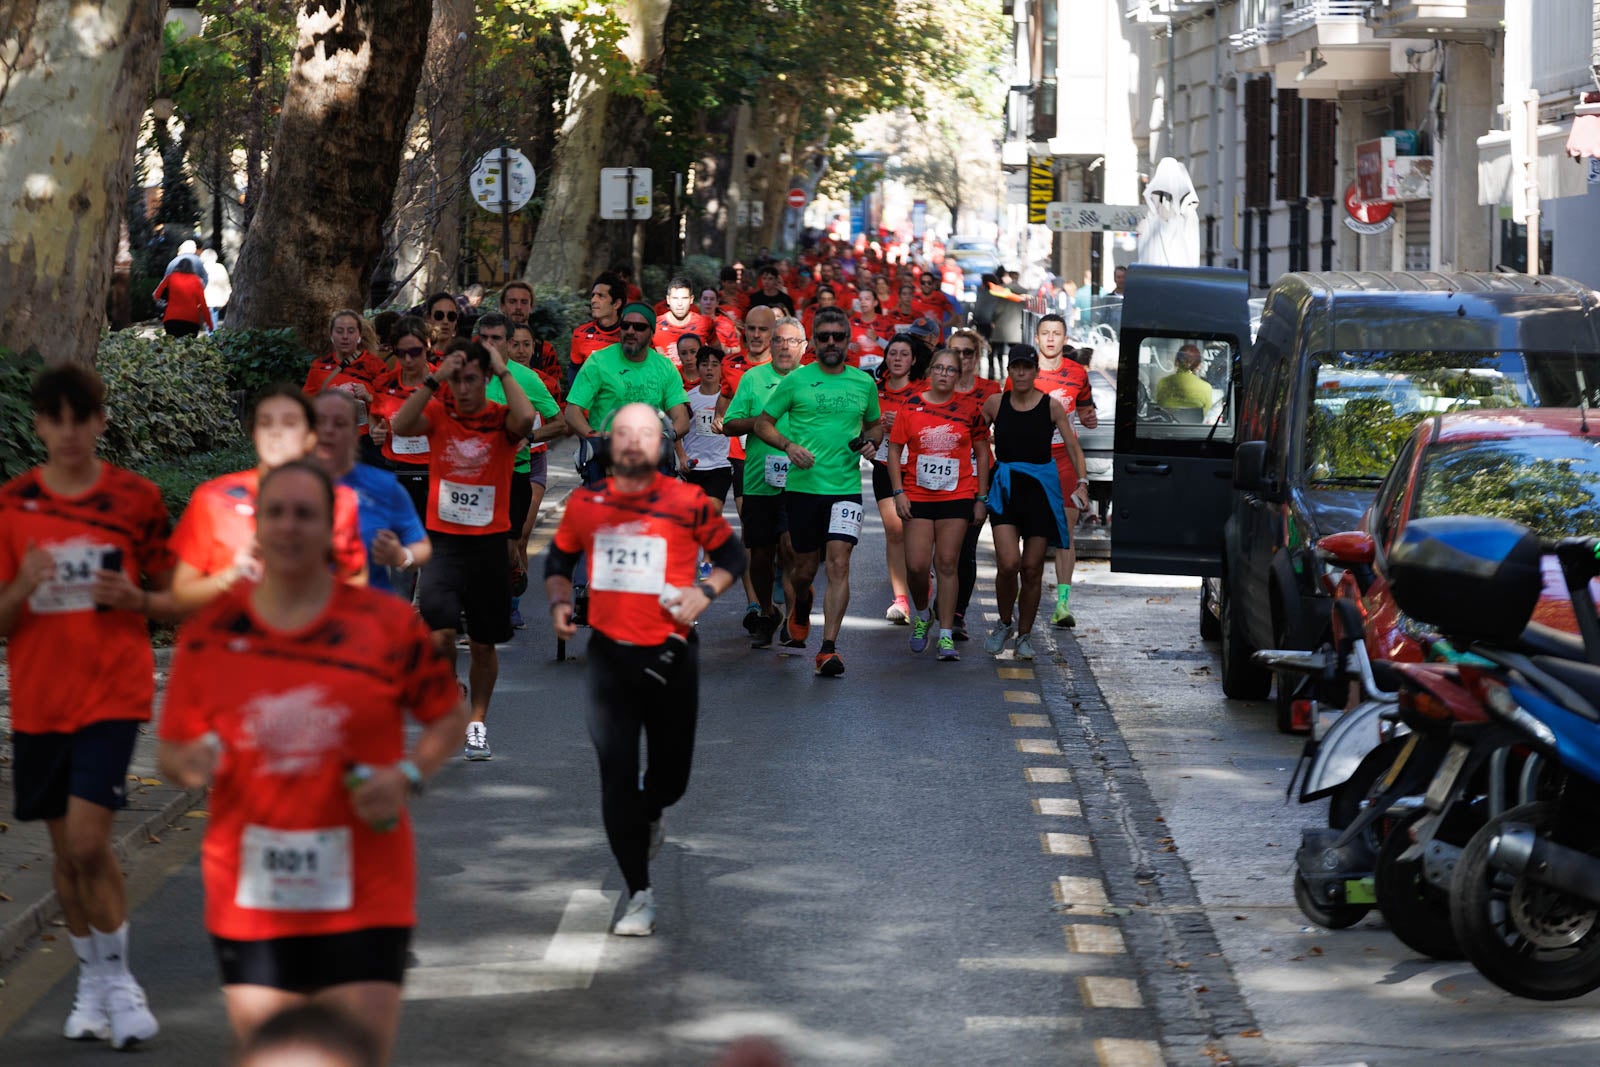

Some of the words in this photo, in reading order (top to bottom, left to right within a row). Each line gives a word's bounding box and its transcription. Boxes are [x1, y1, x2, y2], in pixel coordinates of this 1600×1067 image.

[773, 461, 791, 473] 94
[923, 463, 952, 476] 1215
[450, 491, 480, 507] 992
[841, 507, 862, 523] 910
[606, 547, 651, 566] 1211
